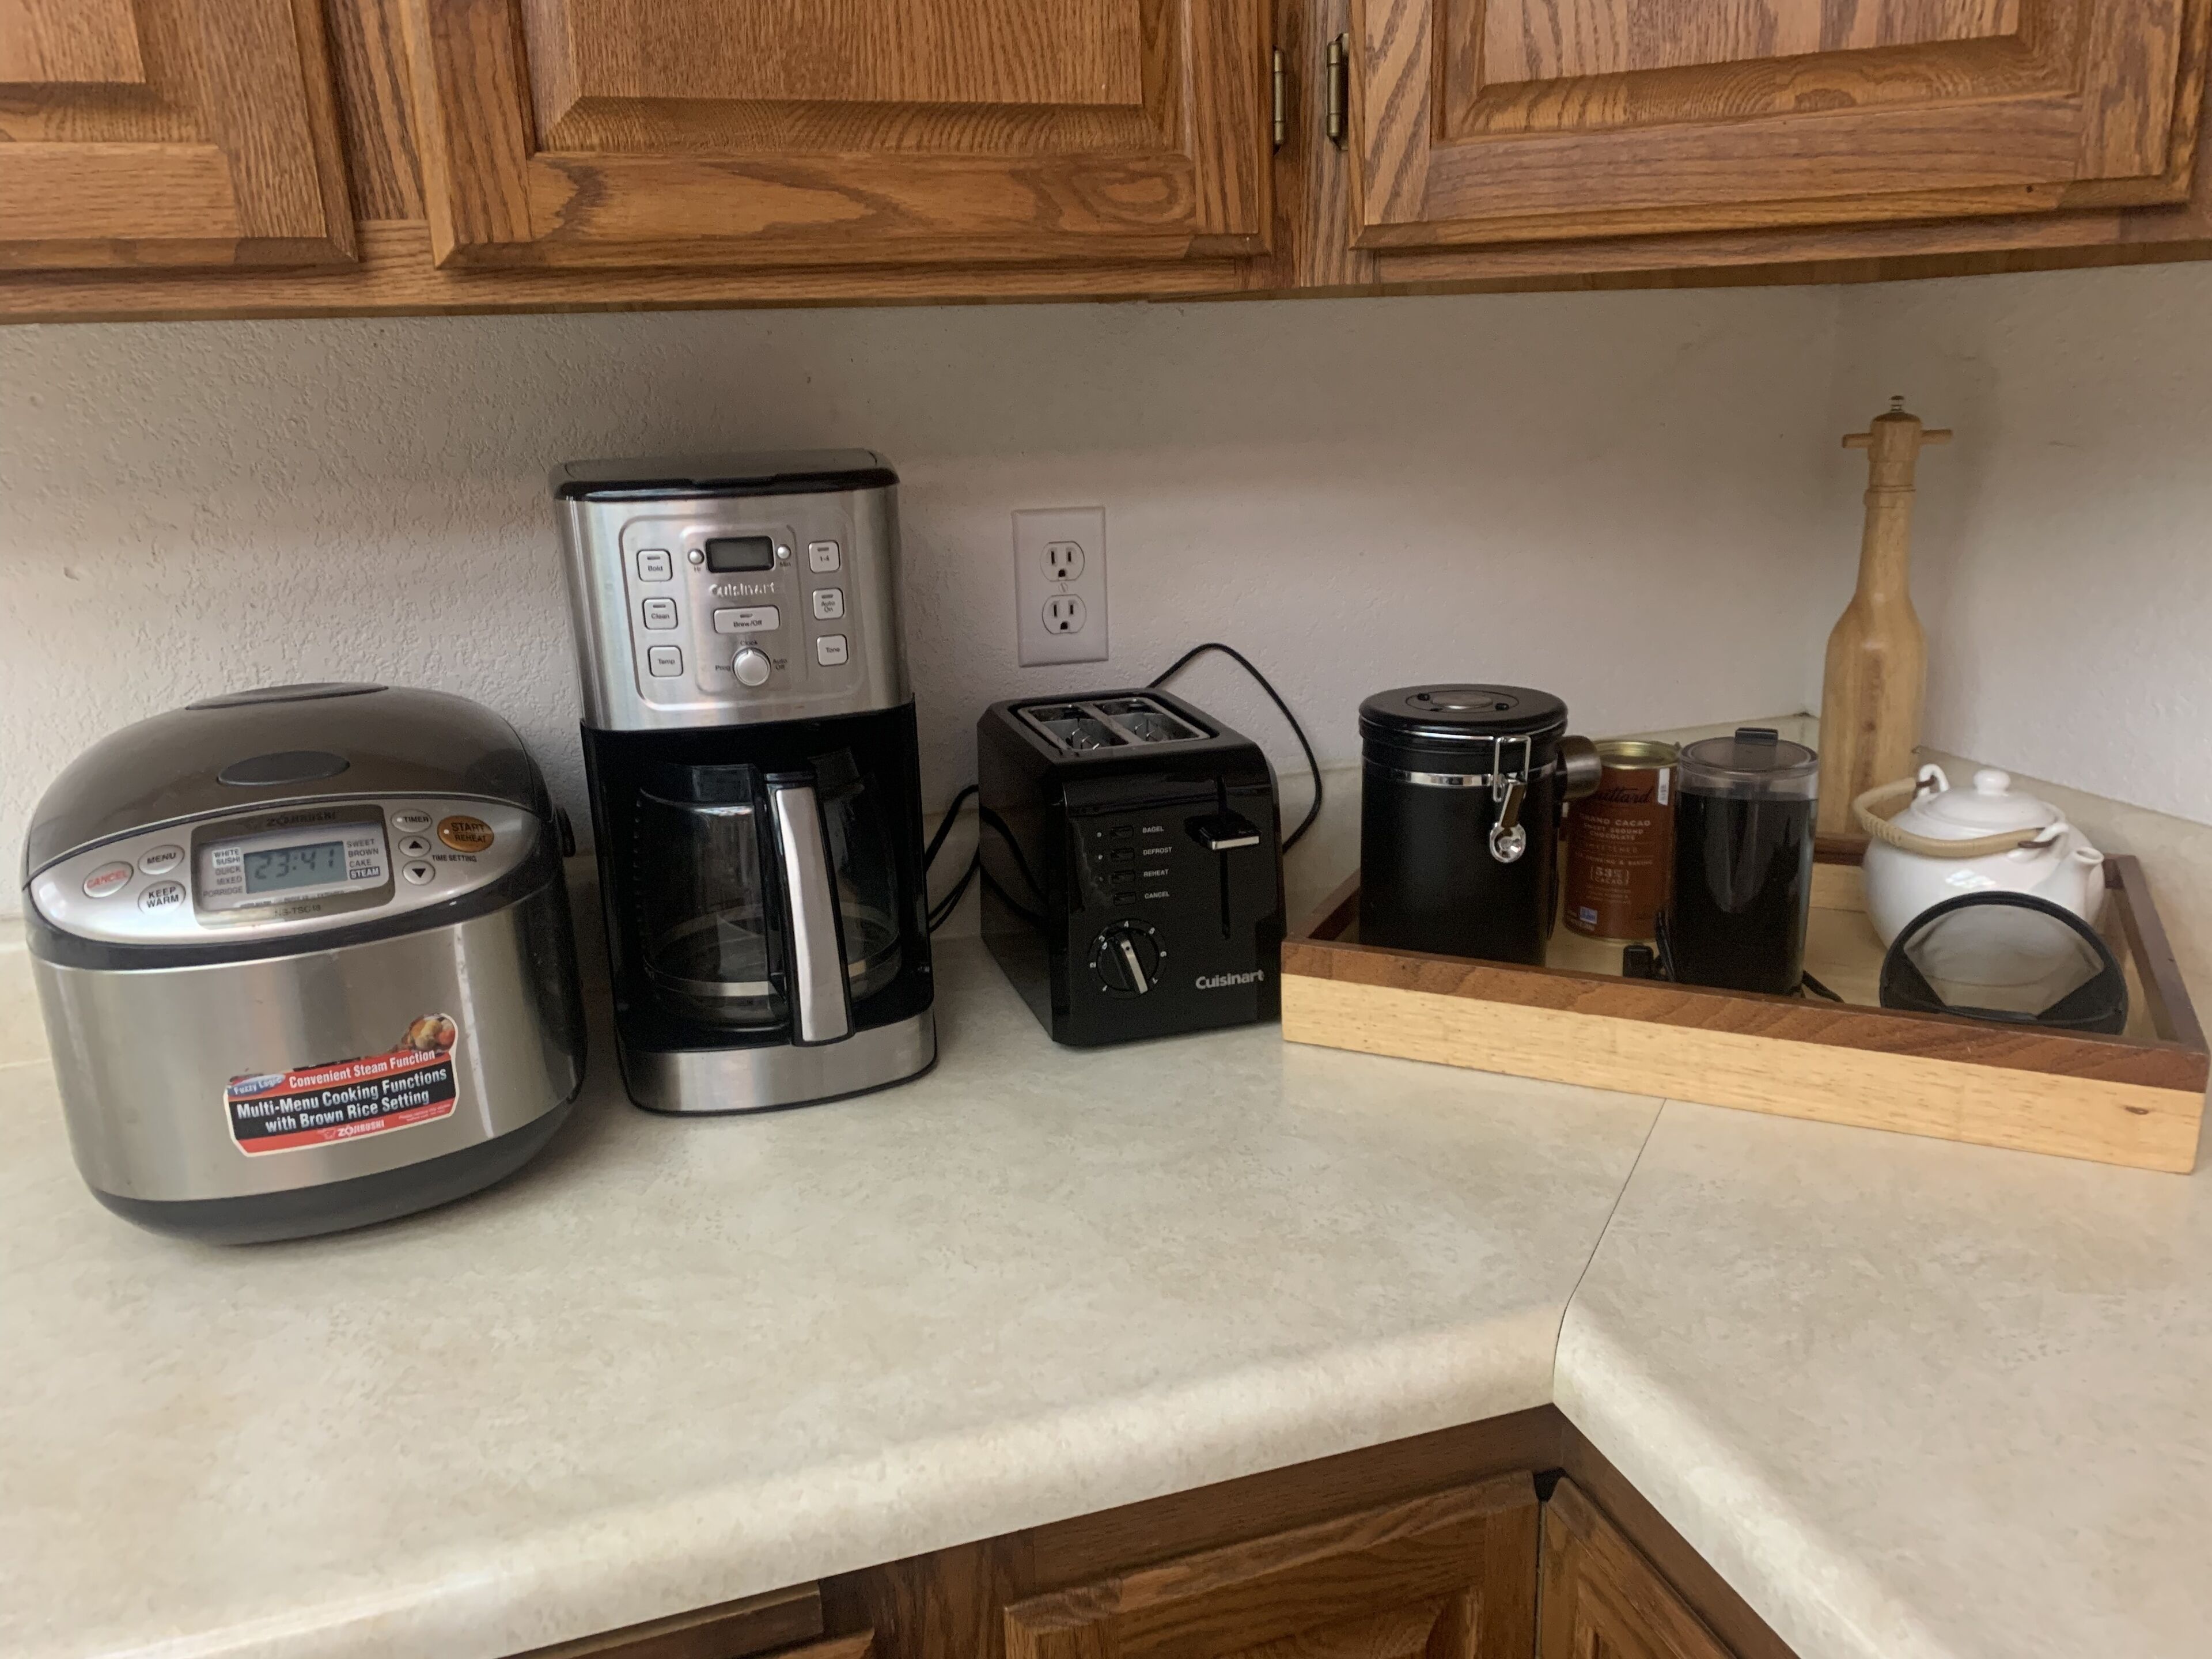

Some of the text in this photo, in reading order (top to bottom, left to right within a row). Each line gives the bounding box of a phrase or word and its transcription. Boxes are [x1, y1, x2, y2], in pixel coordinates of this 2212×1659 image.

[647, 565, 664, 573] Bold
[709, 582, 775, 597] Cuisinart
[651, 612, 671, 620] Clean
[733, 619, 763, 628] Brew/Off
[658, 657, 676, 666] Temp
[451, 822, 485, 832] START
[347, 838, 375, 848] SWEET
[454, 834, 486, 843] REHEAT
[214, 849, 240, 858] WHITE
[348, 847, 379, 858] BROWN
[1143, 846, 1173, 856] DEFROST
[147, 852, 177, 865] MENU
[216, 857, 240, 865] SUSHI
[349, 858, 372, 868] CAKE
[448, 854, 477, 862] SETTING
[254, 849, 335, 880] 23:41
[215, 866, 241, 876] QUICK
[350, 868, 380, 879] STEAM
[1143, 869, 1169, 878] REHEAT
[86, 870, 128, 890] CANCEL
[217, 875, 242, 885] MIXED
[148, 886, 177, 899] KEEP
[202, 886, 243, 897] PORRIDGE
[1144, 891, 1171, 899] CANCEL
[146, 894, 179, 908] WARM
[1195, 969, 1265, 990] Cuisinart
[289, 1050, 435, 1089] Convenient Steam Function
[233, 1075, 283, 1095] Fuzzy Logic
[236, 1068, 447, 1119] Multi-Menu Cooking Functions
[265, 1115, 297, 1134] with
[300, 1109, 344, 1128] Brown
[347, 1103, 378, 1120] Rice
[381, 1090, 430, 1112] Setting
[338, 1119, 385, 1137] ZOJIRUSHI
